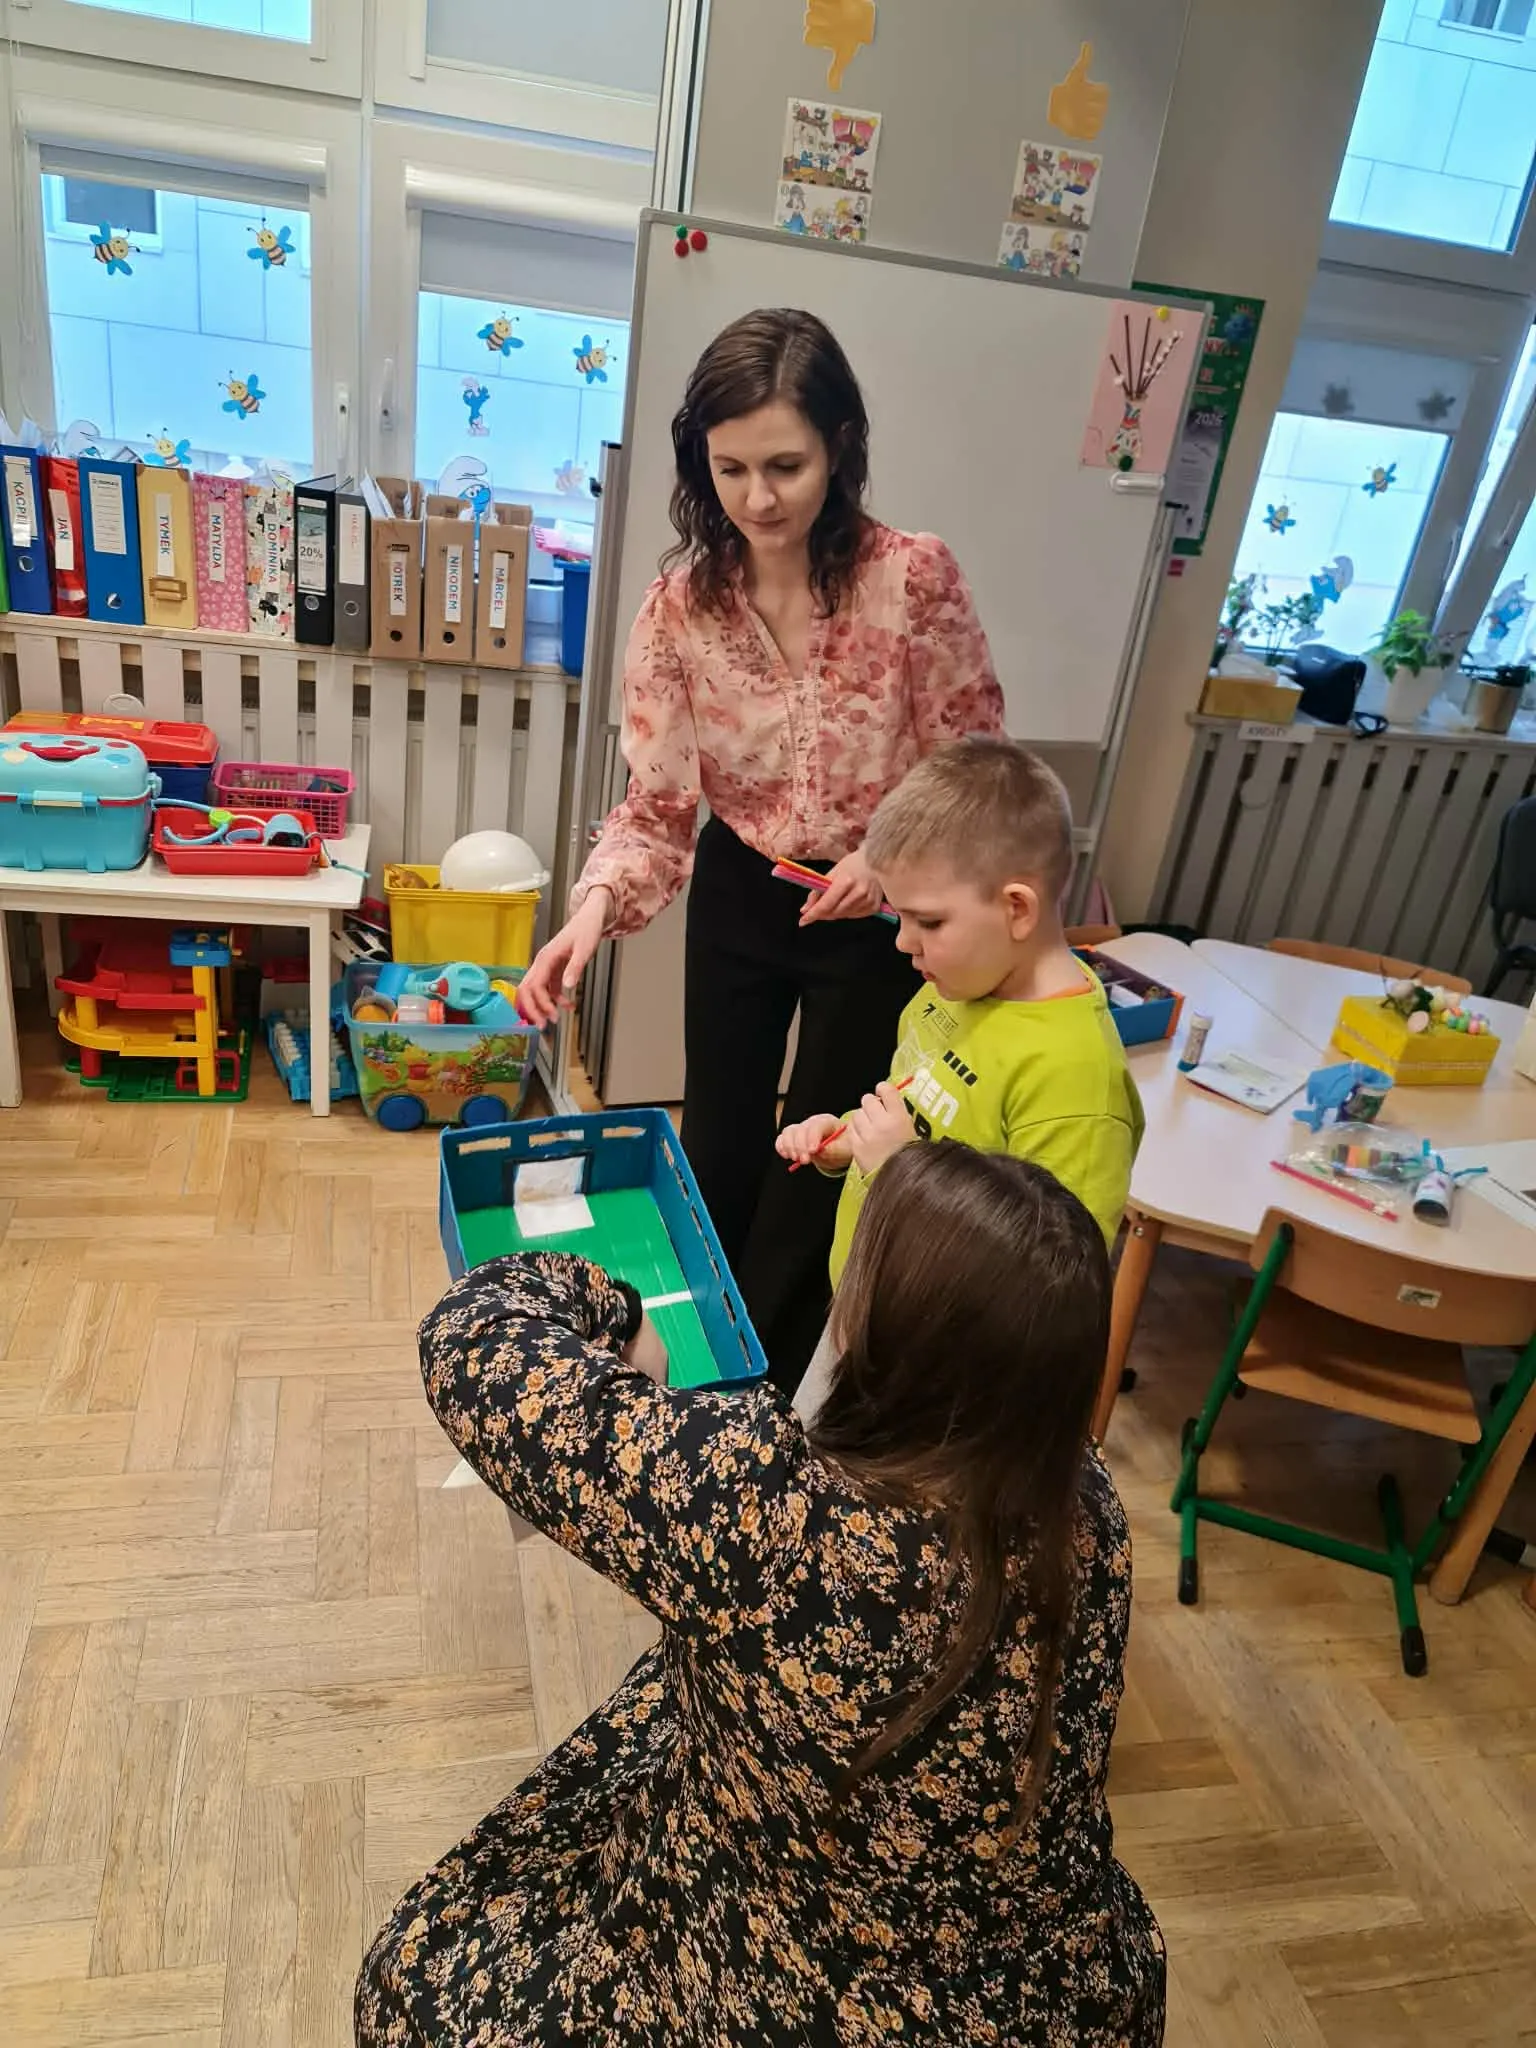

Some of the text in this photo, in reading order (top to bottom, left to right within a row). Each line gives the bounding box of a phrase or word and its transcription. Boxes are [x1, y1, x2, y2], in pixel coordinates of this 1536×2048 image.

[57, 518, 69, 539] JAN
[159, 515, 170, 555] TYMEK
[212, 514, 221, 569] MATYLDA
[267, 523, 278, 583] DOMINIKA
[300, 546, 323, 559] 20%
[448, 556, 459, 610] NIKODEM
[494, 567, 504, 612] MARCEL
